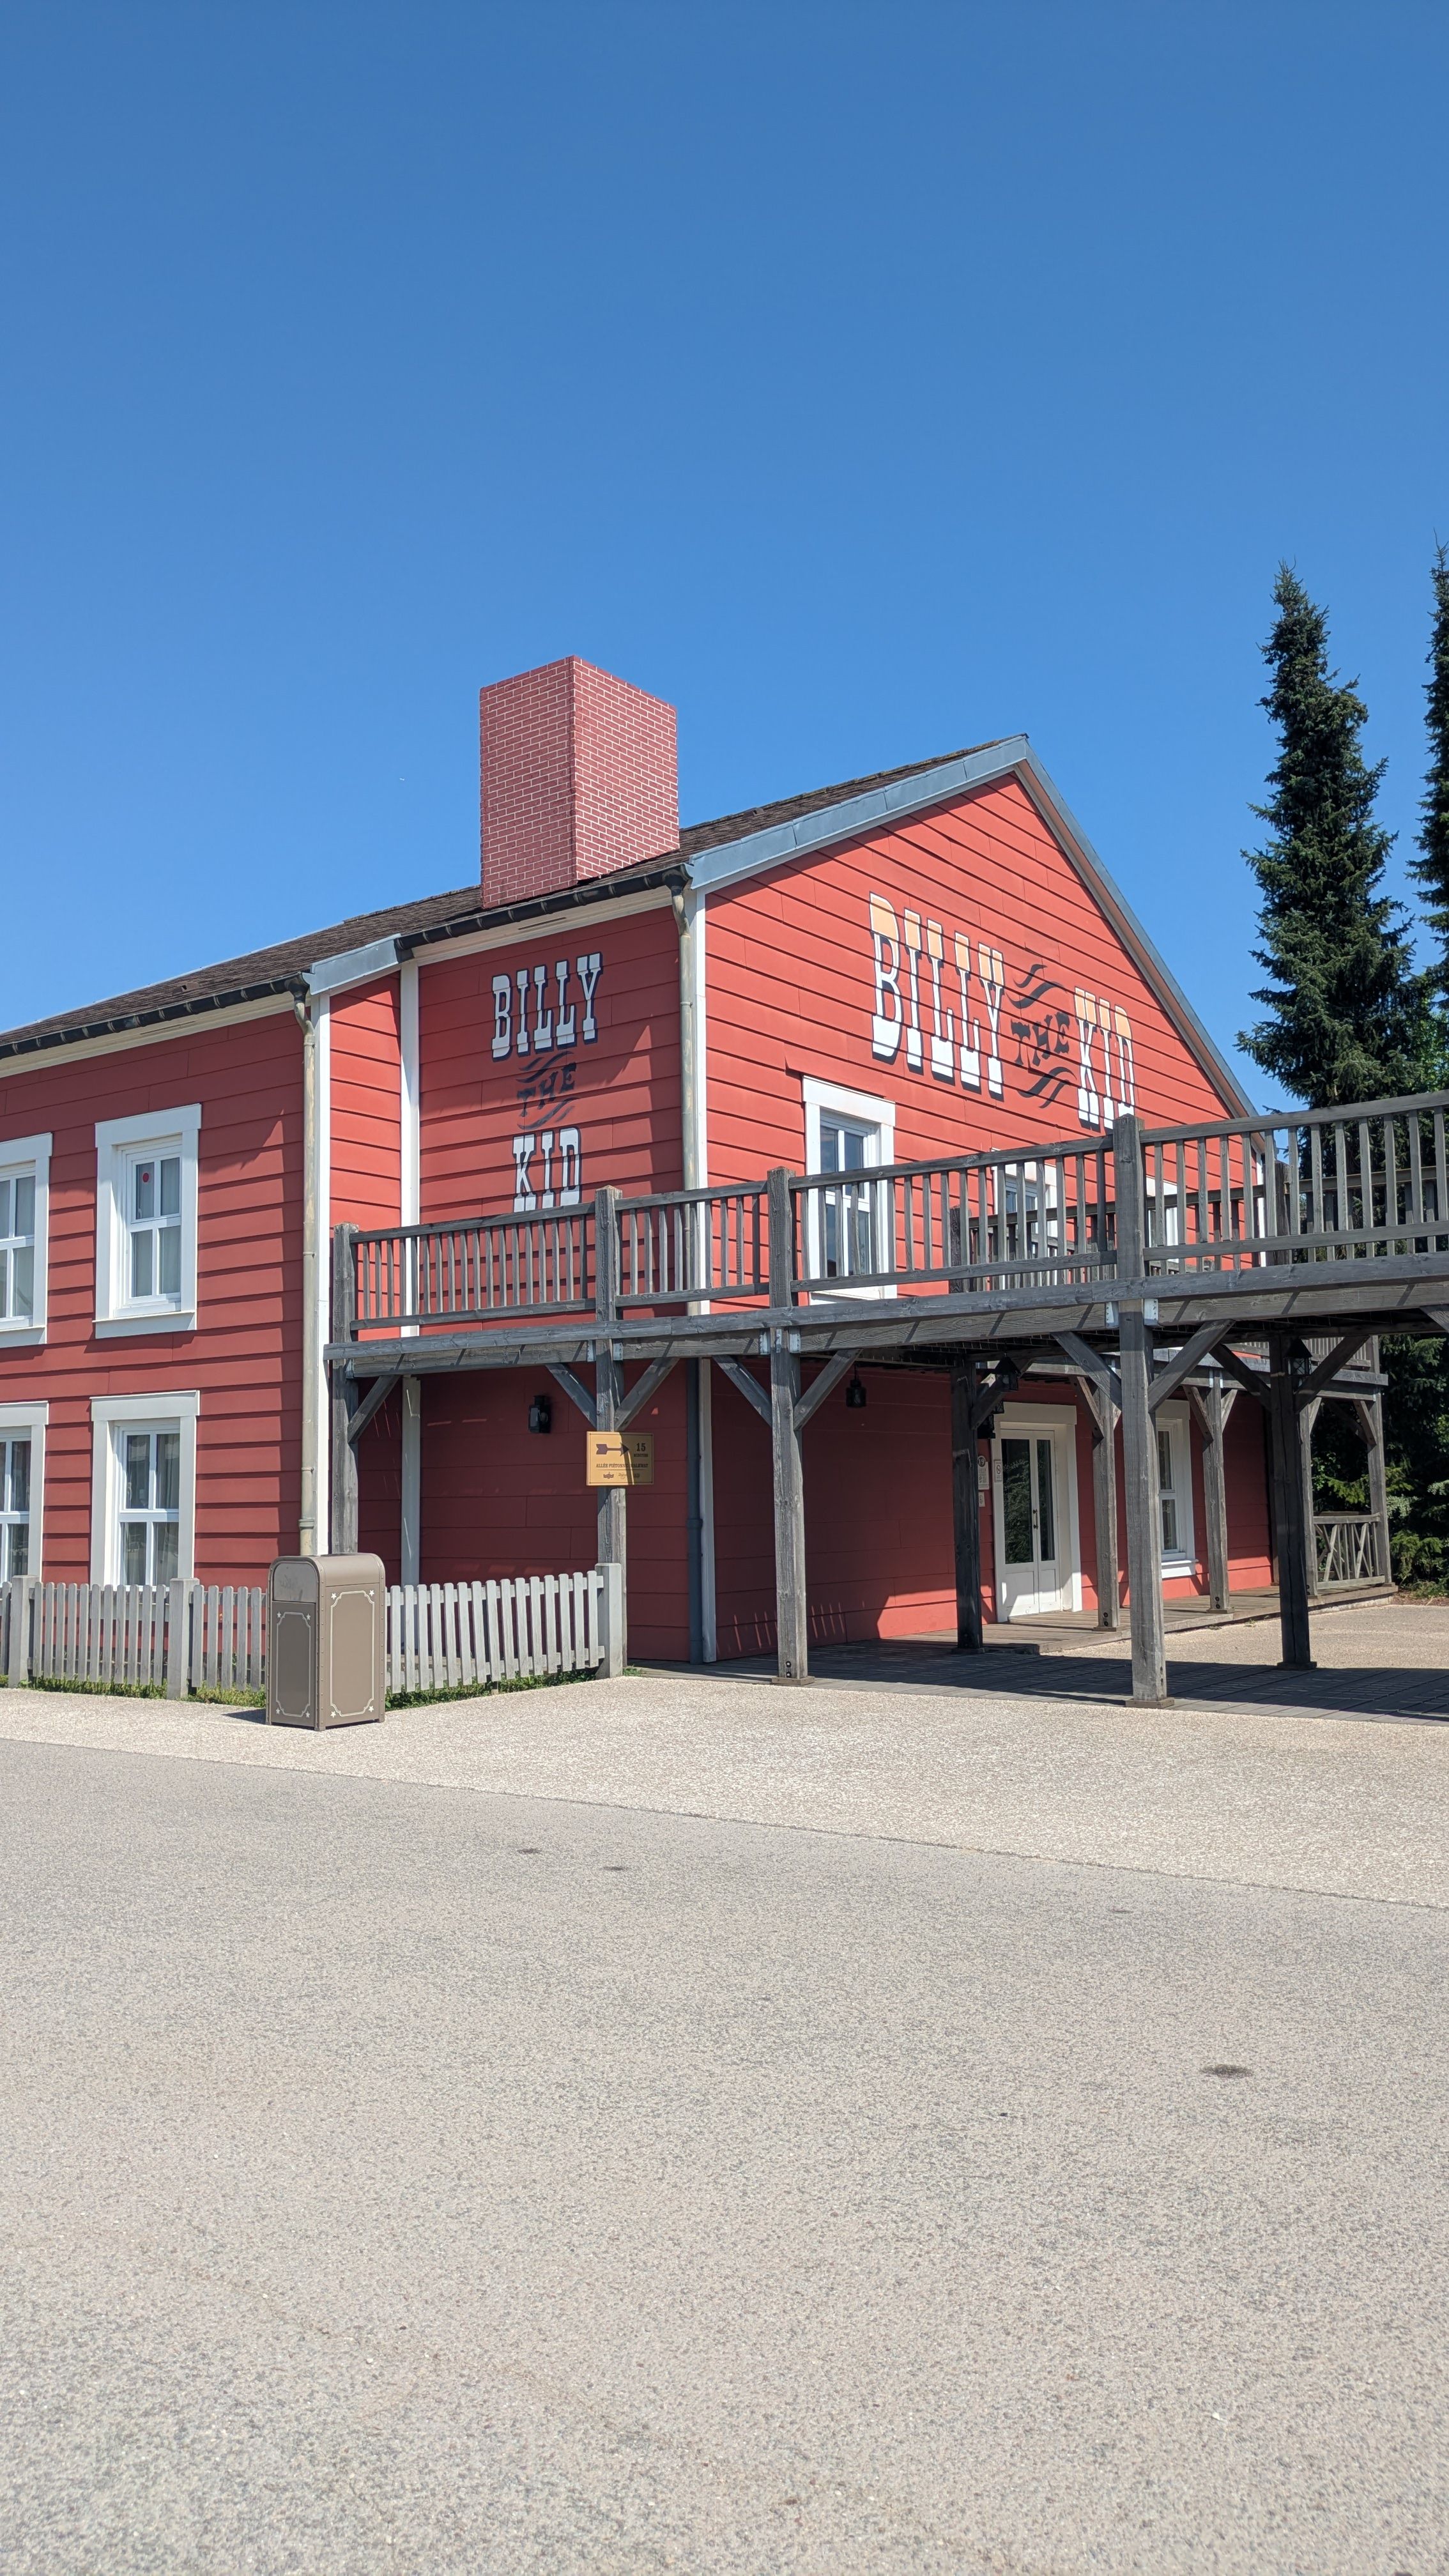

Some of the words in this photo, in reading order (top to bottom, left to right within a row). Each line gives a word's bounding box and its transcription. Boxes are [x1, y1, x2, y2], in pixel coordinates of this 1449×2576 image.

[492, 952, 602, 1061] BILLY
[870, 891, 1004, 1101] BILLY
[1011, 1011, 1070, 1067] THE
[1073, 986, 1135, 1133] KID
[517, 1062, 577, 1117] THE
[513, 1127, 582, 1213] KID
[636, 1443, 646, 1452] 15
